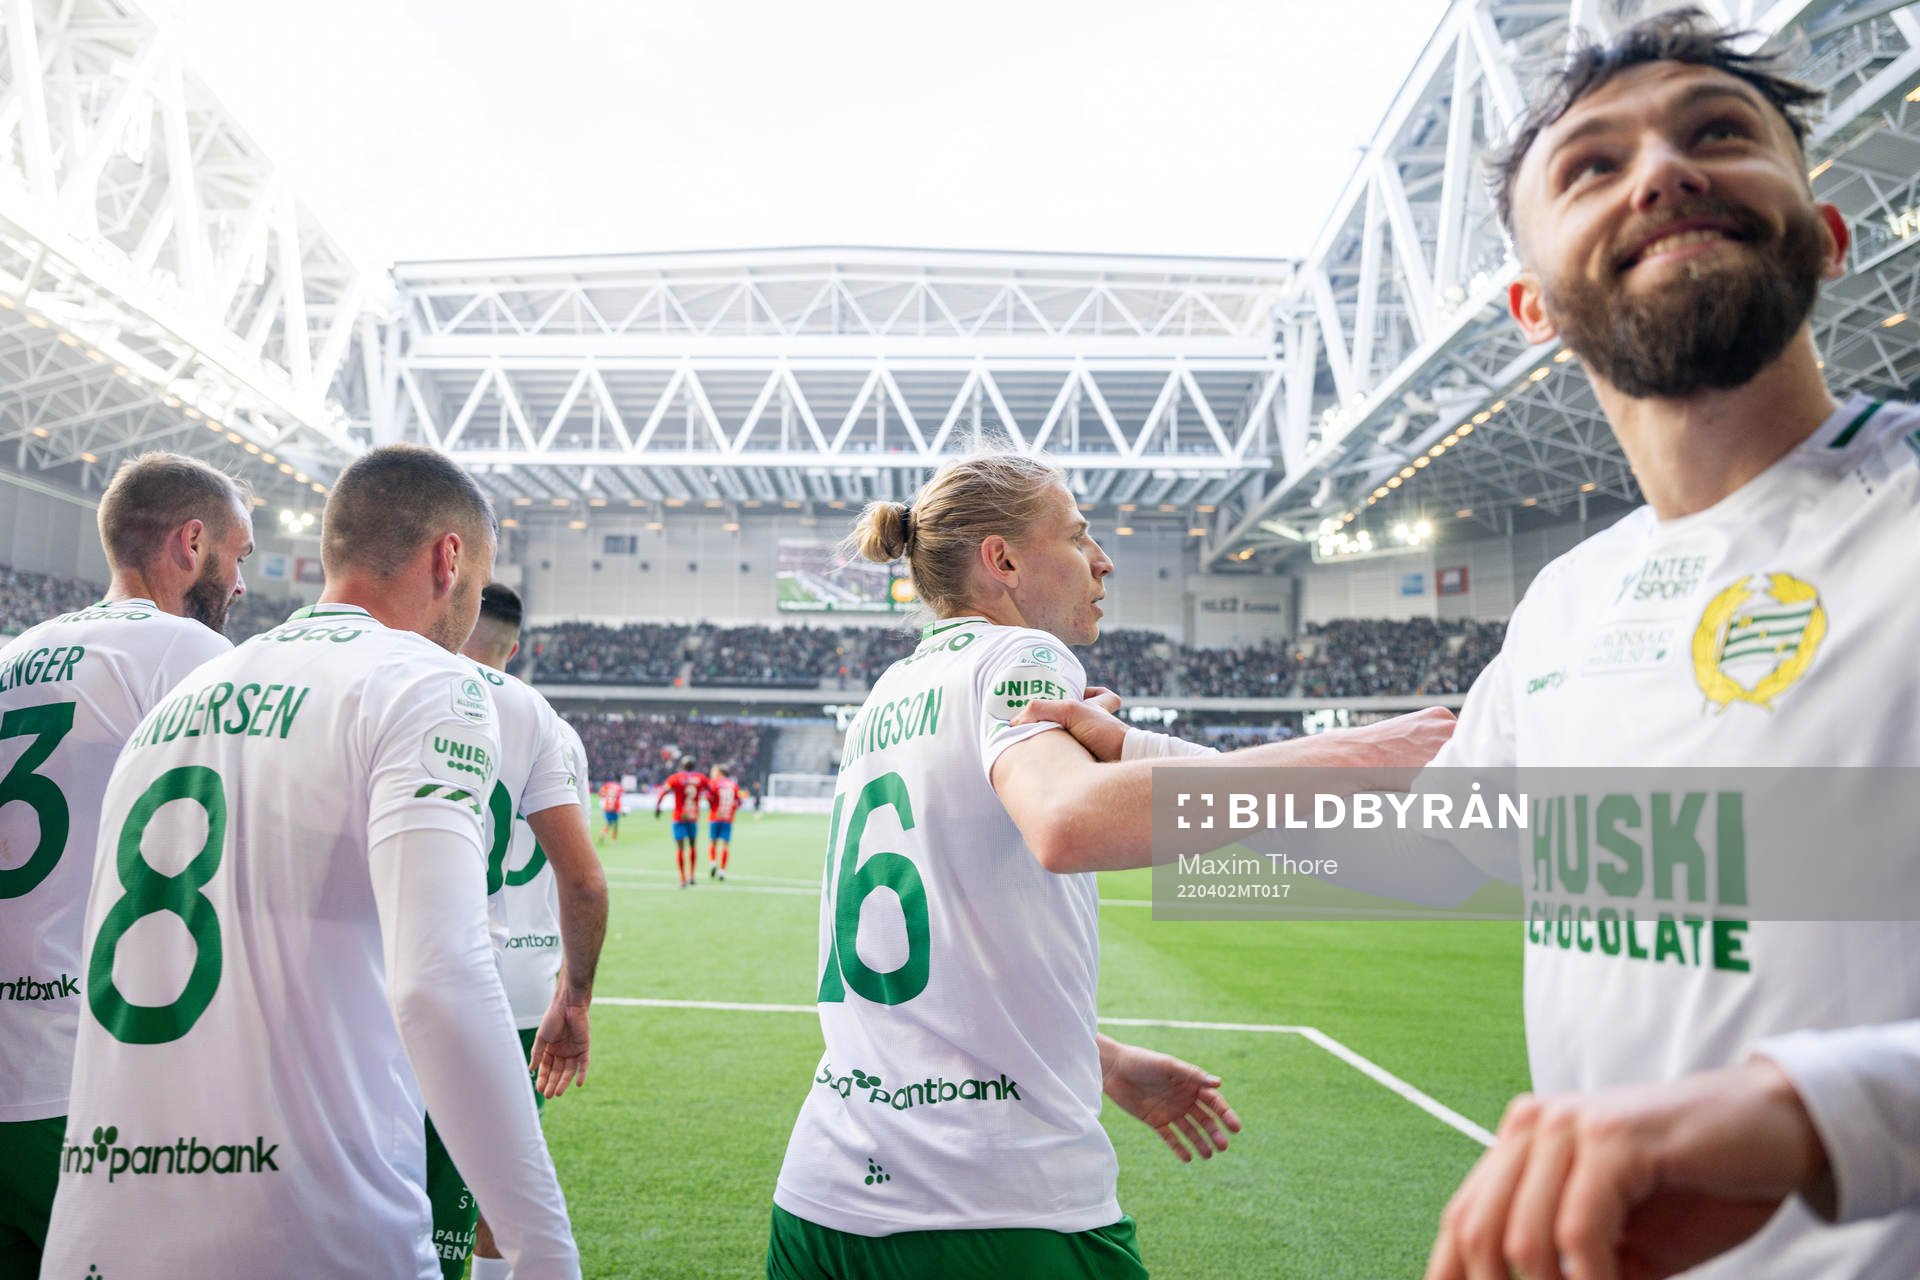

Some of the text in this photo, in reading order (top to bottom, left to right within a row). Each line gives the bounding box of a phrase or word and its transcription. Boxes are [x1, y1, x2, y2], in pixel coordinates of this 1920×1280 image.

[0, 645, 86, 693] ENGER
[993, 679, 1067, 700] UNIBET
[1533, 791, 1748, 907] HUSKI
[87, 765, 228, 1045] 8
[505, 933, 560, 949] antban
[1529, 901, 1751, 973] CHOCOLATE
[0, 973, 81, 1002] ntbank
[109, 1136, 280, 1183] pantbank
